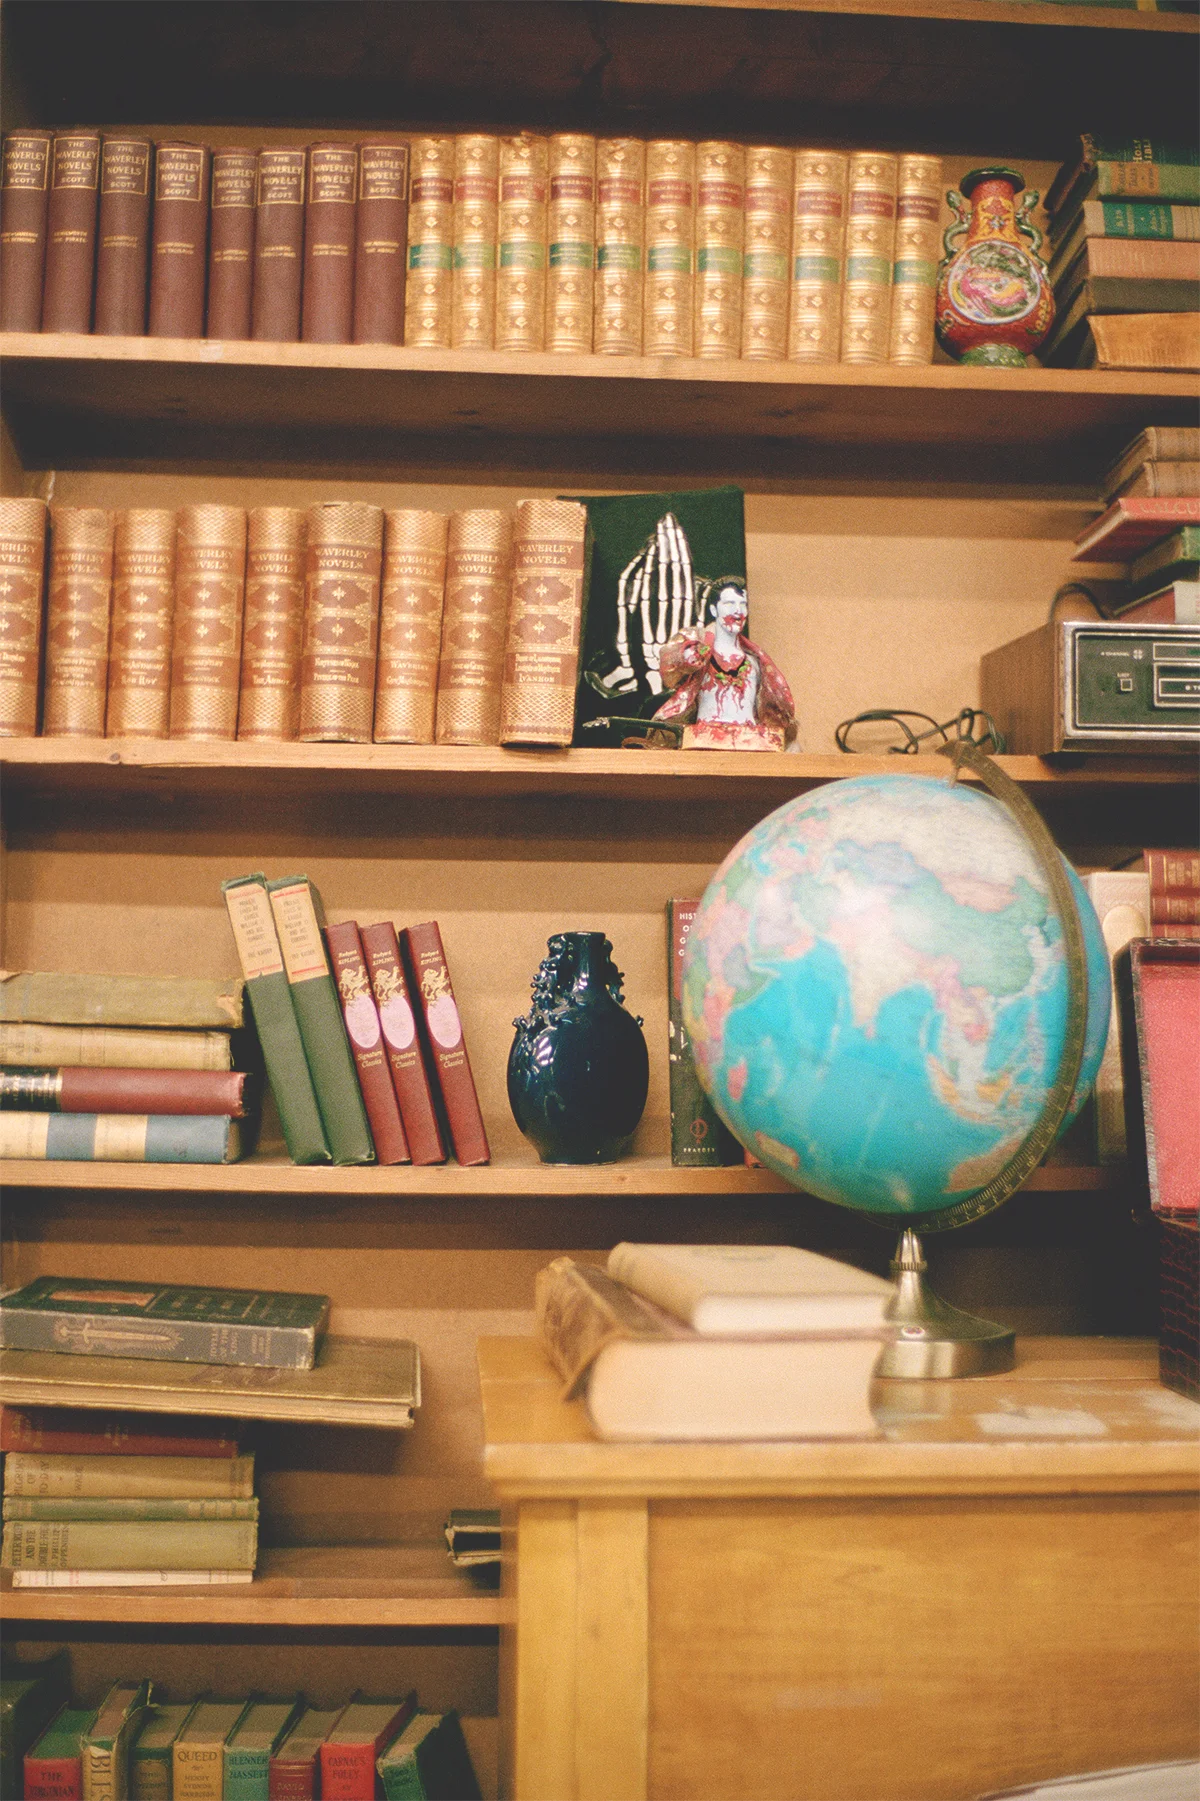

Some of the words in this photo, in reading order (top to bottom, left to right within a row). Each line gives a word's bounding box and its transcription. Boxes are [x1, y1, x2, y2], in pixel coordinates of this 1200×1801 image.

[108, 167, 141, 175] NOVELS
[1140, 502, 1200, 514] CALCU
[0, 543, 35, 552] ERLEY
[519, 544, 574, 554] WAVERLEY
[524, 556, 567, 565] NOVELS
[178, 1751, 217, 1762] QUEED
[41, 1772, 62, 1782] THE
